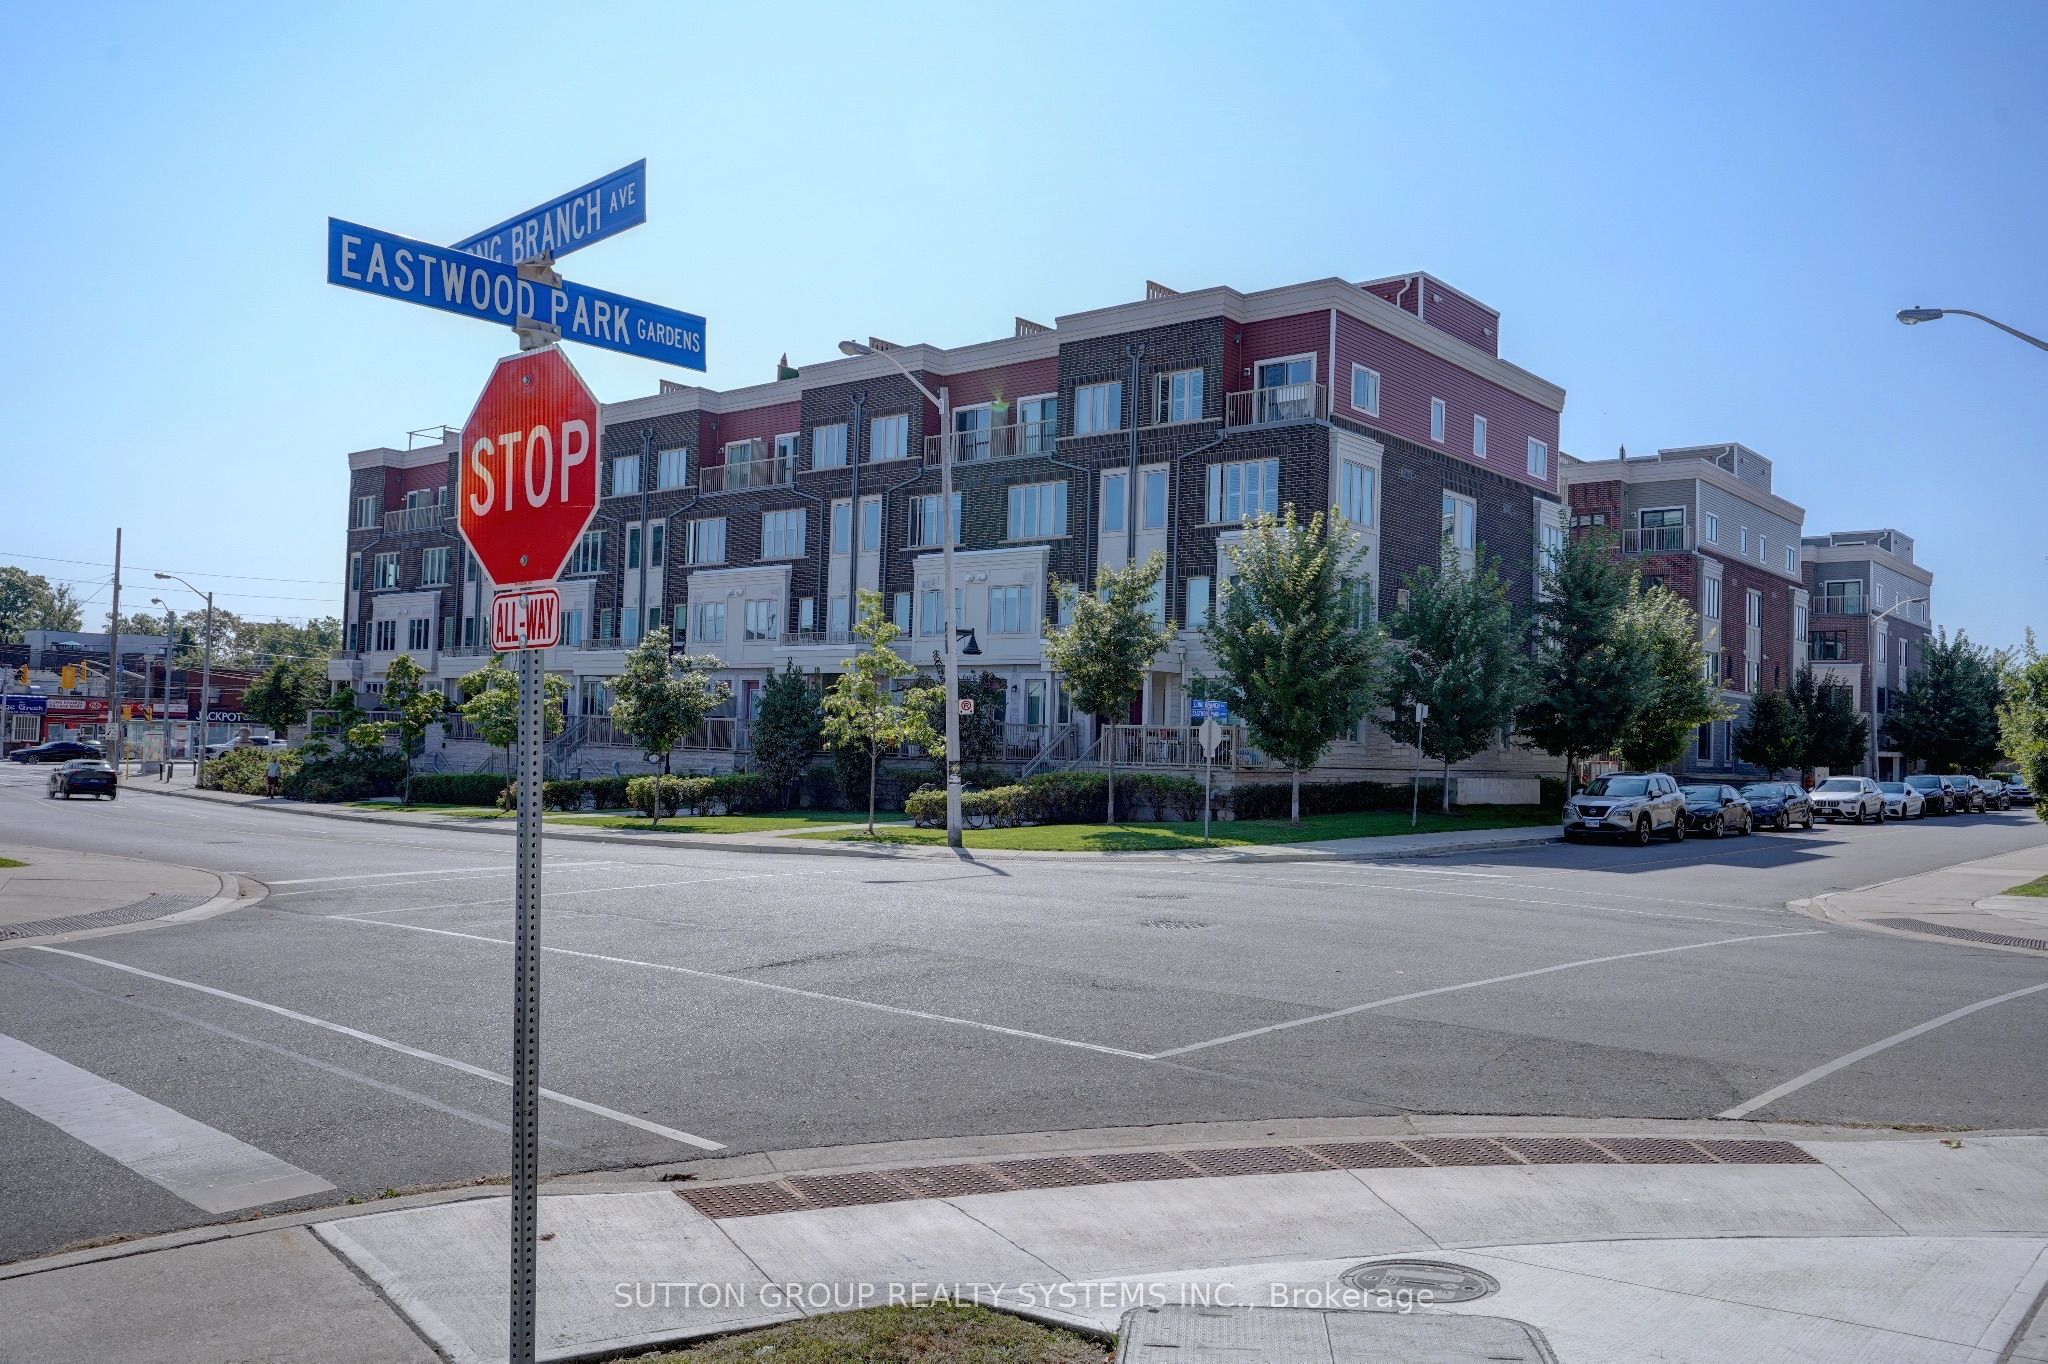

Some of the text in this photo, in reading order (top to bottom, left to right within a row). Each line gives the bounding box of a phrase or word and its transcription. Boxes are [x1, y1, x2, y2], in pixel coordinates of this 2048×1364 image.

[466, 181, 637, 266] NG BRANCH AVE
[341, 233, 700, 354] EASTWOOD PARK GARDENS
[469, 418, 590, 517] STOP
[495, 597, 555, 644] ALL-WAY
[195, 710, 241, 721] JCKPOT
